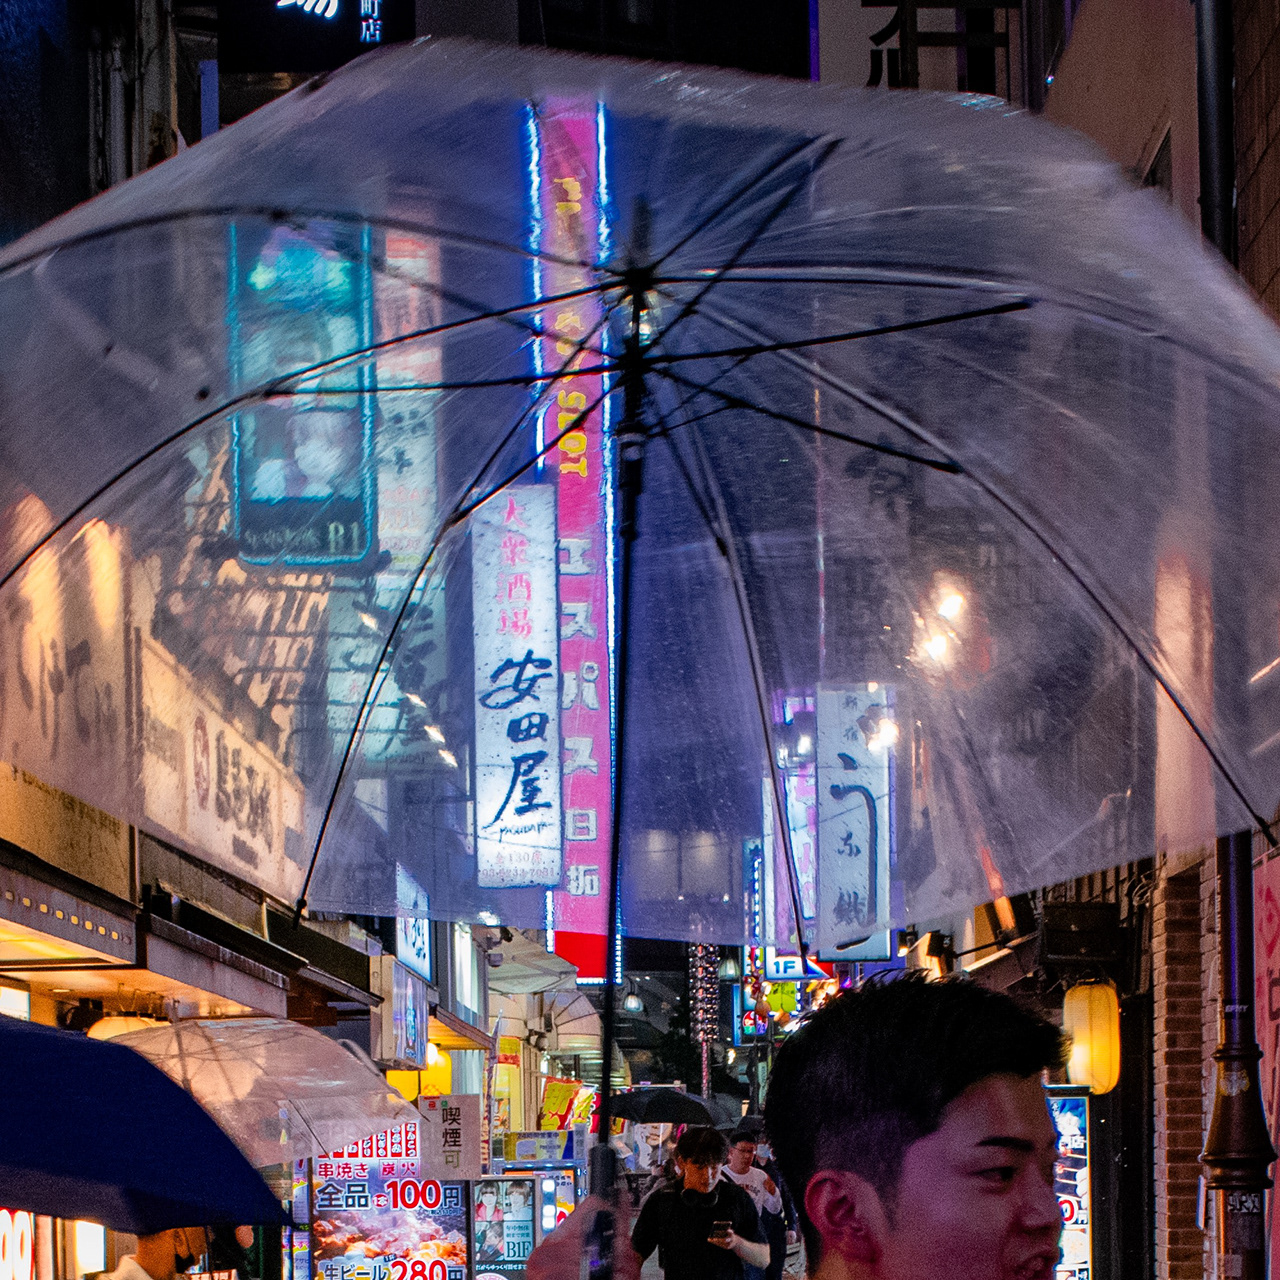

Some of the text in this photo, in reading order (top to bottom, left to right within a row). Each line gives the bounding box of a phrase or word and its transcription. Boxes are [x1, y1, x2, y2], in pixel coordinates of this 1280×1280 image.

[557, 388, 589, 479] SLOT
[495, 496, 533, 640] 大衆酒場
[479, 648, 553, 830] 安田屋
[558, 537, 601, 898] エスパス日拓
[773, 959, 796, 974] 1F
[441, 1106, 462, 1169] 喫煙可
[317, 1181, 369, 1209] 全品
[386, 1180, 462, 1209] 100円
[318, 1162, 416, 1179] 串焼き 炭火
[506, 1241, 532, 1258] B1F
